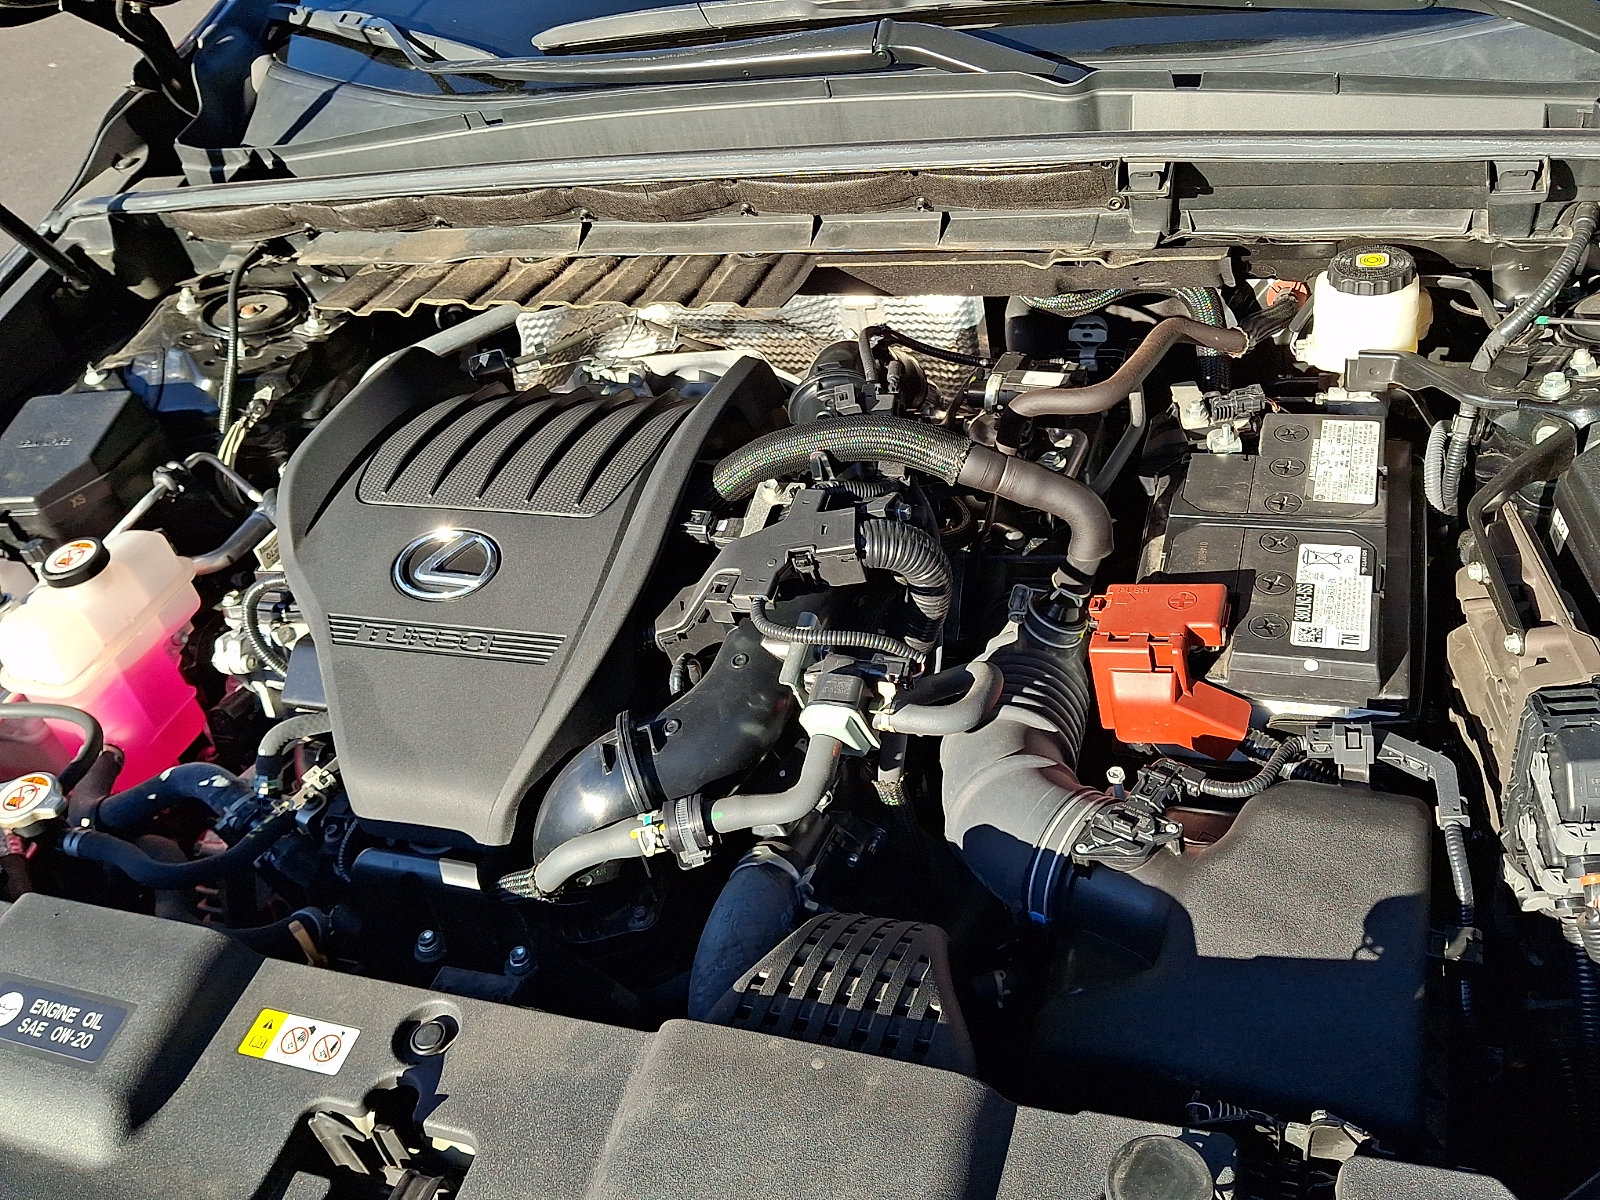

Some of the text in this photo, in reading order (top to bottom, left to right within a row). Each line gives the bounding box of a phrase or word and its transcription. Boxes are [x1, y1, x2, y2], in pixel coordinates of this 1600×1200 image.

[1293, 584, 1313, 622] 380LN3-ISS
[354, 622, 494, 653] TURBO
[1340, 633, 1360, 646] TN
[29, 998, 104, 1031] ENGINE OIL
[17, 1018, 94, 1050] SAE 0W-20
